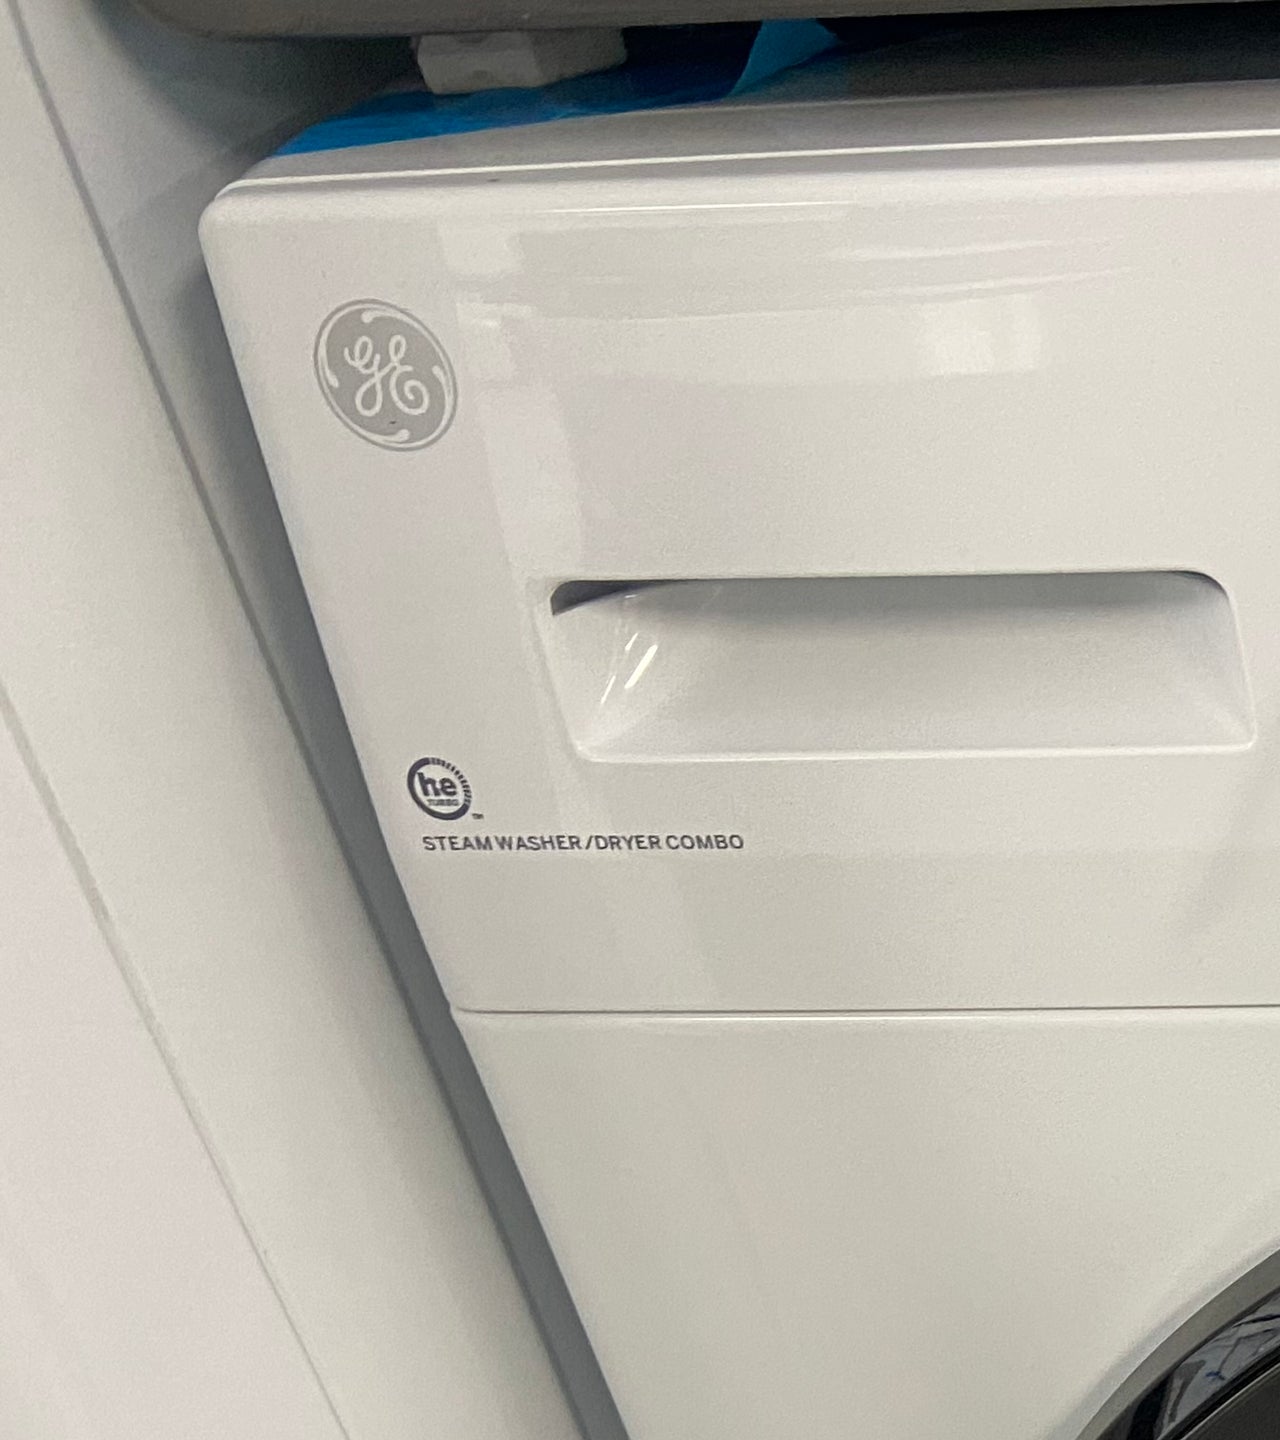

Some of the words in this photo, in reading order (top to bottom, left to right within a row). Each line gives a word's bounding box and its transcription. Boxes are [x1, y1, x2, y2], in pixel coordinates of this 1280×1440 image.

[417, 772, 458, 797] he
[422, 837, 492, 851] STEAM
[665, 835, 744, 850] COMBO
